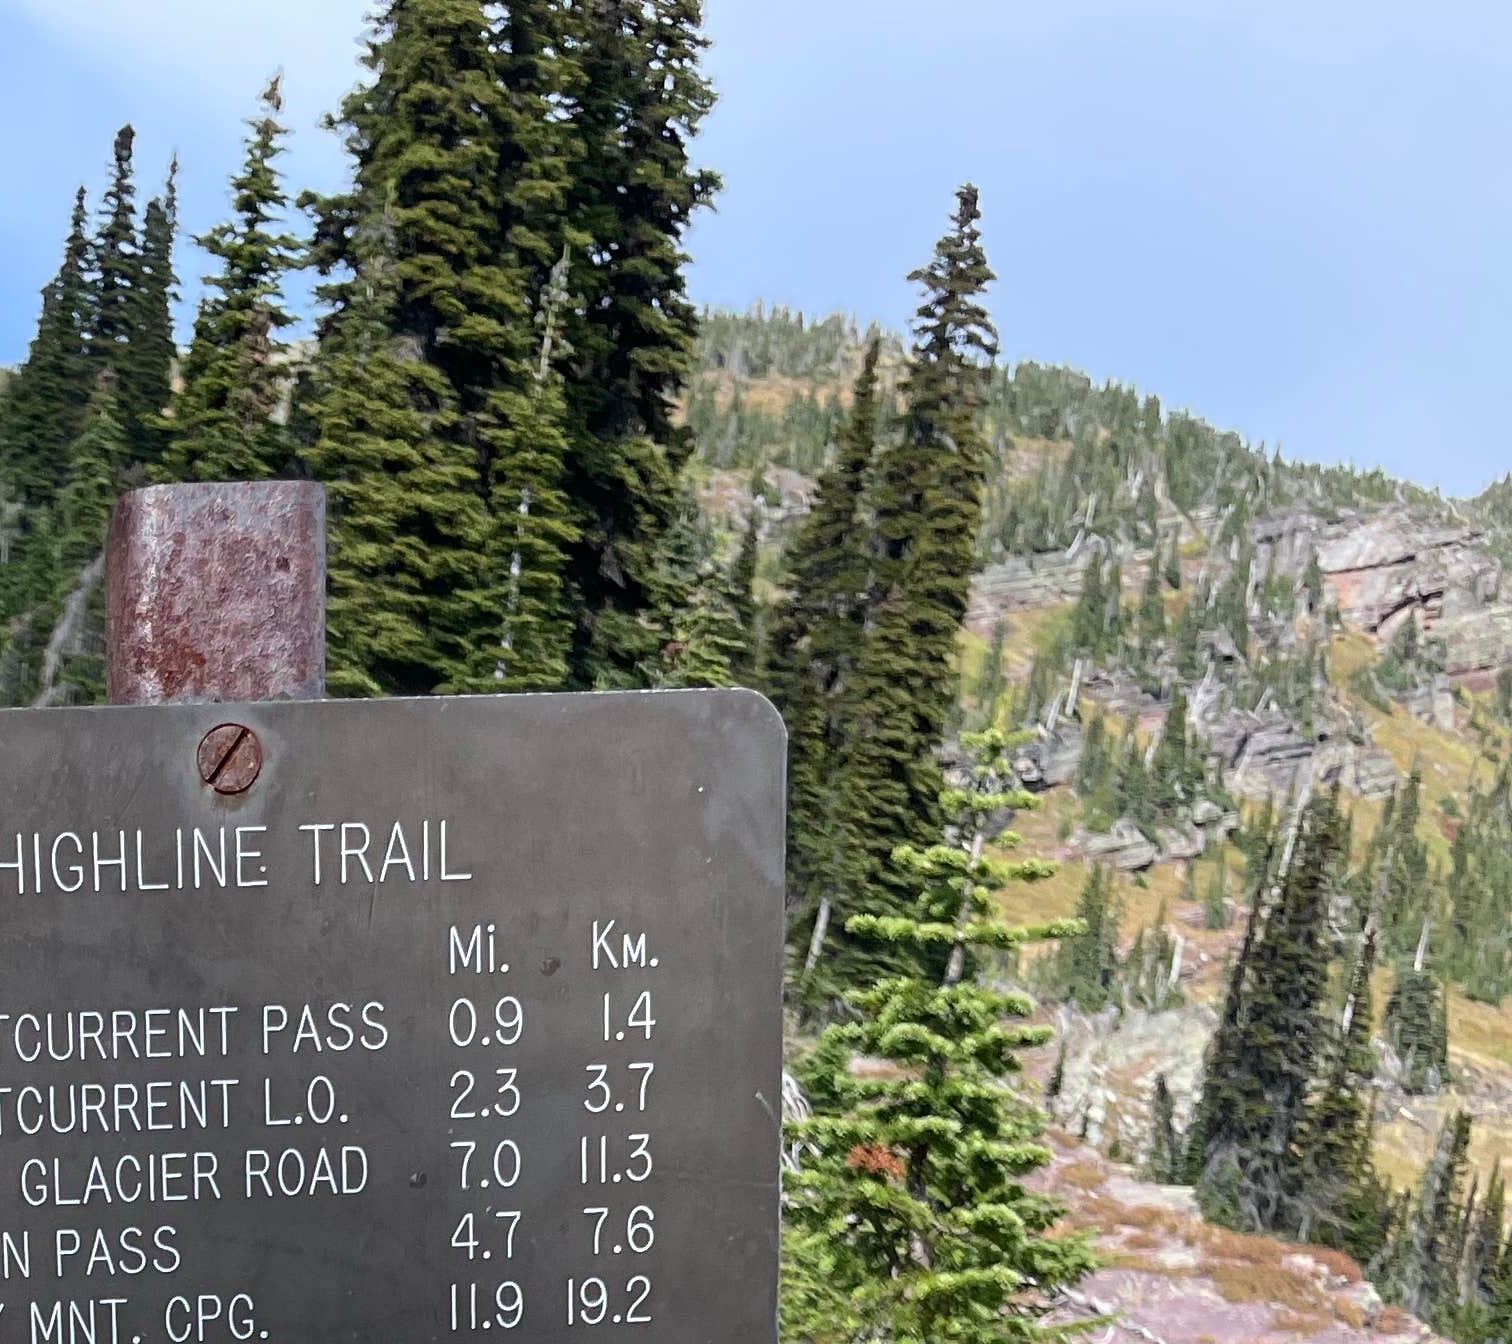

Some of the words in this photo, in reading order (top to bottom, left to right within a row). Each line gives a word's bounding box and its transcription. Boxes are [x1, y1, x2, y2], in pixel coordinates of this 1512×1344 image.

[299, 820, 472, 884] TRAIL
[449, 924, 510, 974] Mi.
[264, 1001, 388, 1054] PASS
[449, 996, 523, 1047] 0.9
[603, 990, 657, 1041] 1.4
[265, 1075, 348, 1126] L.O.
[450, 1067, 521, 1119] 2.3
[583, 1062, 654, 1113] 3.7
[21, 1152, 220, 1206] GLACIER
[245, 1145, 368, 1198] ROAD
[450, 1140, 521, 1189] 7.0
[581, 1134, 653, 1184] 11.3
[56, 1225, 181, 1277] PASS
[451, 1210, 521, 1260] 4.7
[583, 1205, 655, 1255] 7.6
[165, 1293, 270, 1343] CPG.
[451, 1281, 523, 1331] 11.9
[568, 1275, 652, 1325] 19.2
